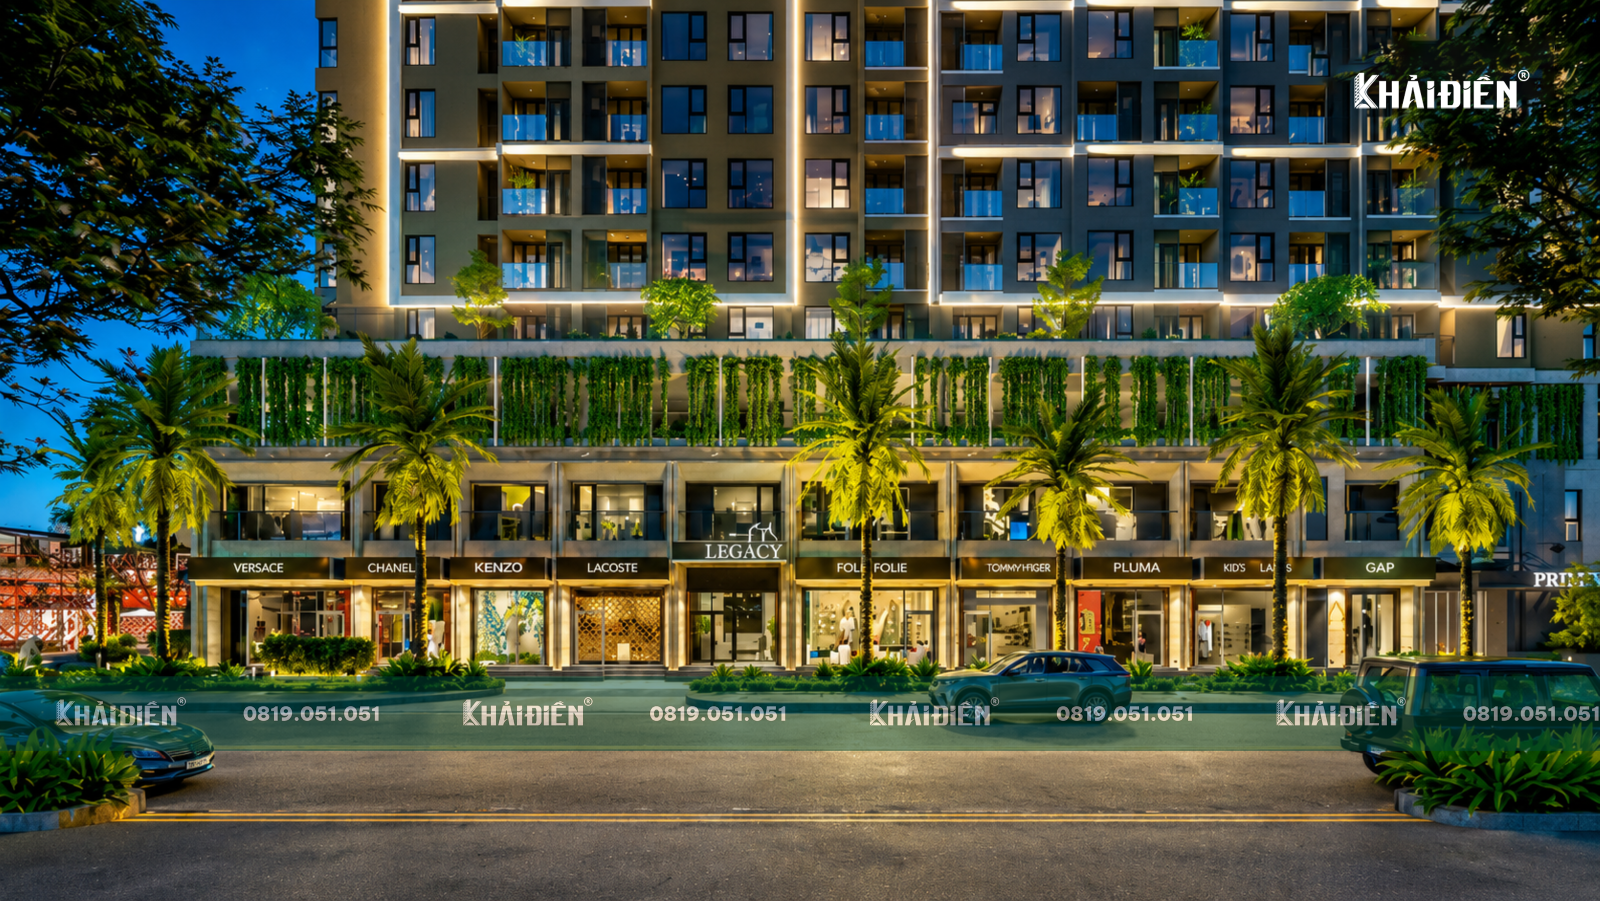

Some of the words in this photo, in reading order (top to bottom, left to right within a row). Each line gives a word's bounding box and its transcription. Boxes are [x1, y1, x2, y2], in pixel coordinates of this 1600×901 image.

[704, 543, 783, 560] LEGACY
[233, 562, 284, 573] VERSACE
[367, 562, 416, 573] CHANEL
[474, 562, 523, 573] KENZO
[587, 562, 638, 573] LACOSTE
[873, 562, 908, 573] FOLIE
[1113, 562, 1161, 573] PLUMA
[1365, 562, 1395, 573] GAP
